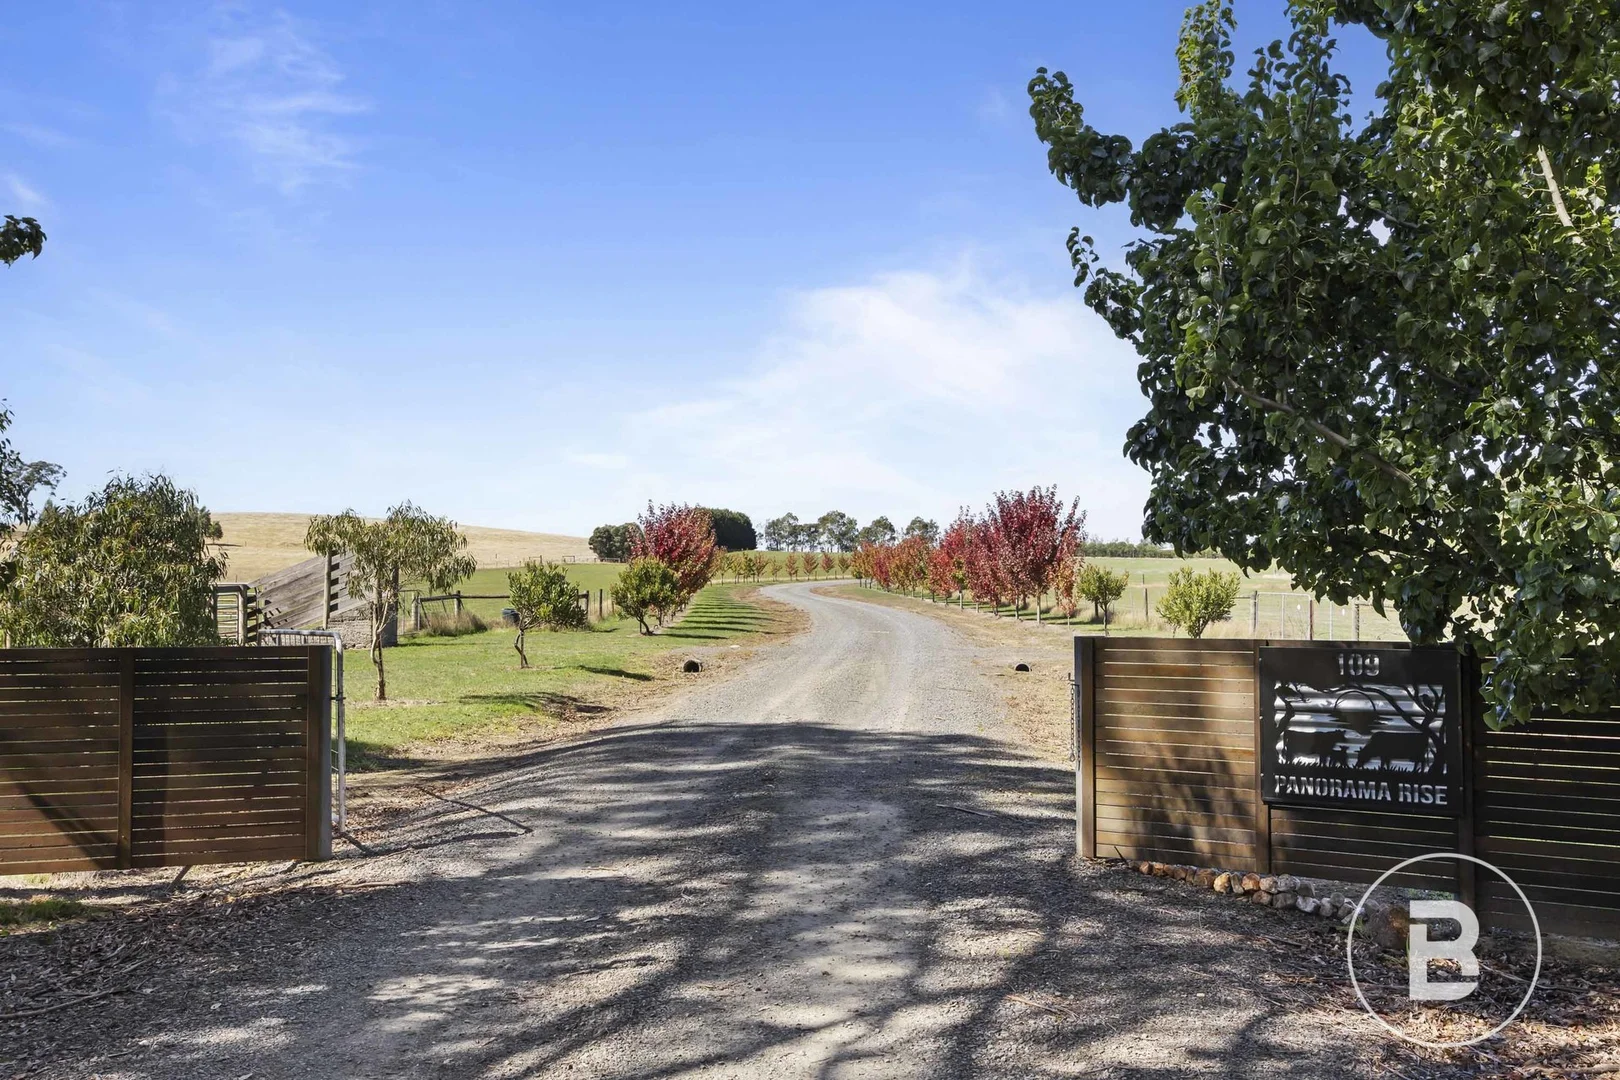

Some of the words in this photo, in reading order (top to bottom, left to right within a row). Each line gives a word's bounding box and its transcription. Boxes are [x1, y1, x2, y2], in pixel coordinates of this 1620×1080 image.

[1338, 653, 1380, 676] 109
[1274, 775, 1391, 801] PANORAMA
[1398, 783, 1448, 805] RISE
